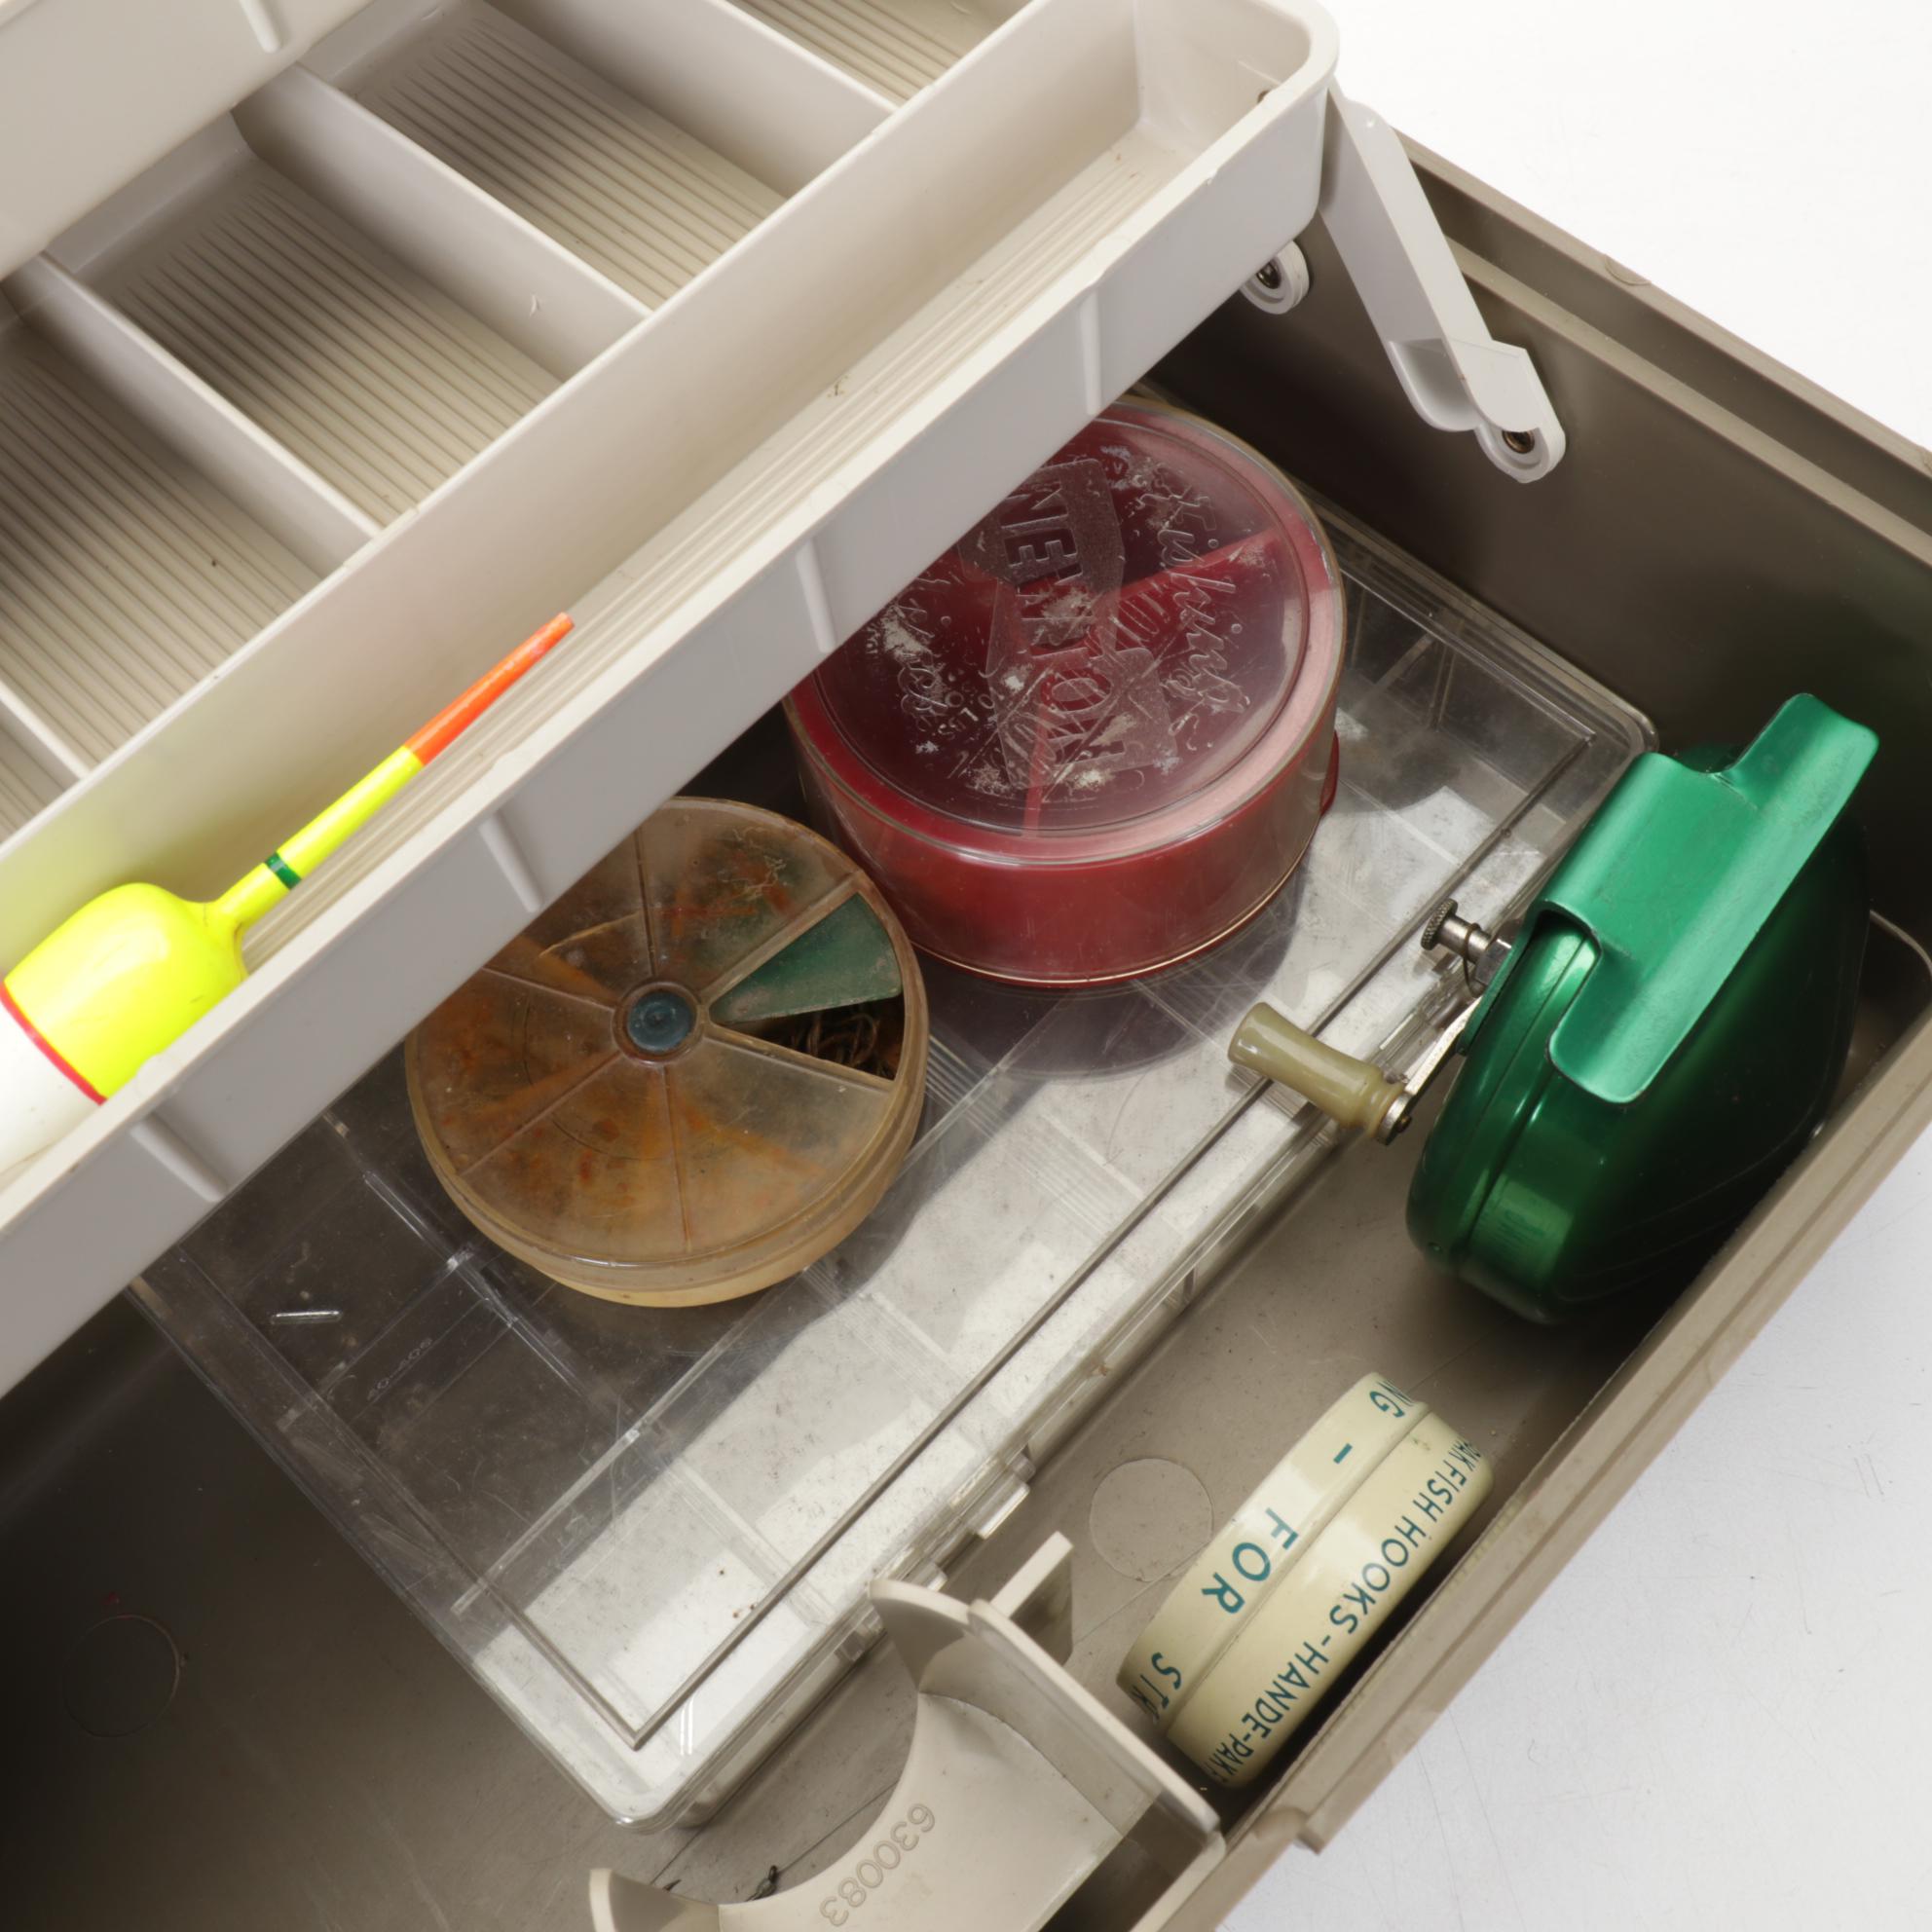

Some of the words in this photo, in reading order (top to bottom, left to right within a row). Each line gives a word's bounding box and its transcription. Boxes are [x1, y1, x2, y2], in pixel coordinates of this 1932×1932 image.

[1412, 1459, 1468, 1522] FISH
[1201, 1506, 1299, 1615] FOR
[1329, 1514, 1427, 1635] HOOKS
[819, 1803, 936, 1927] 630083
